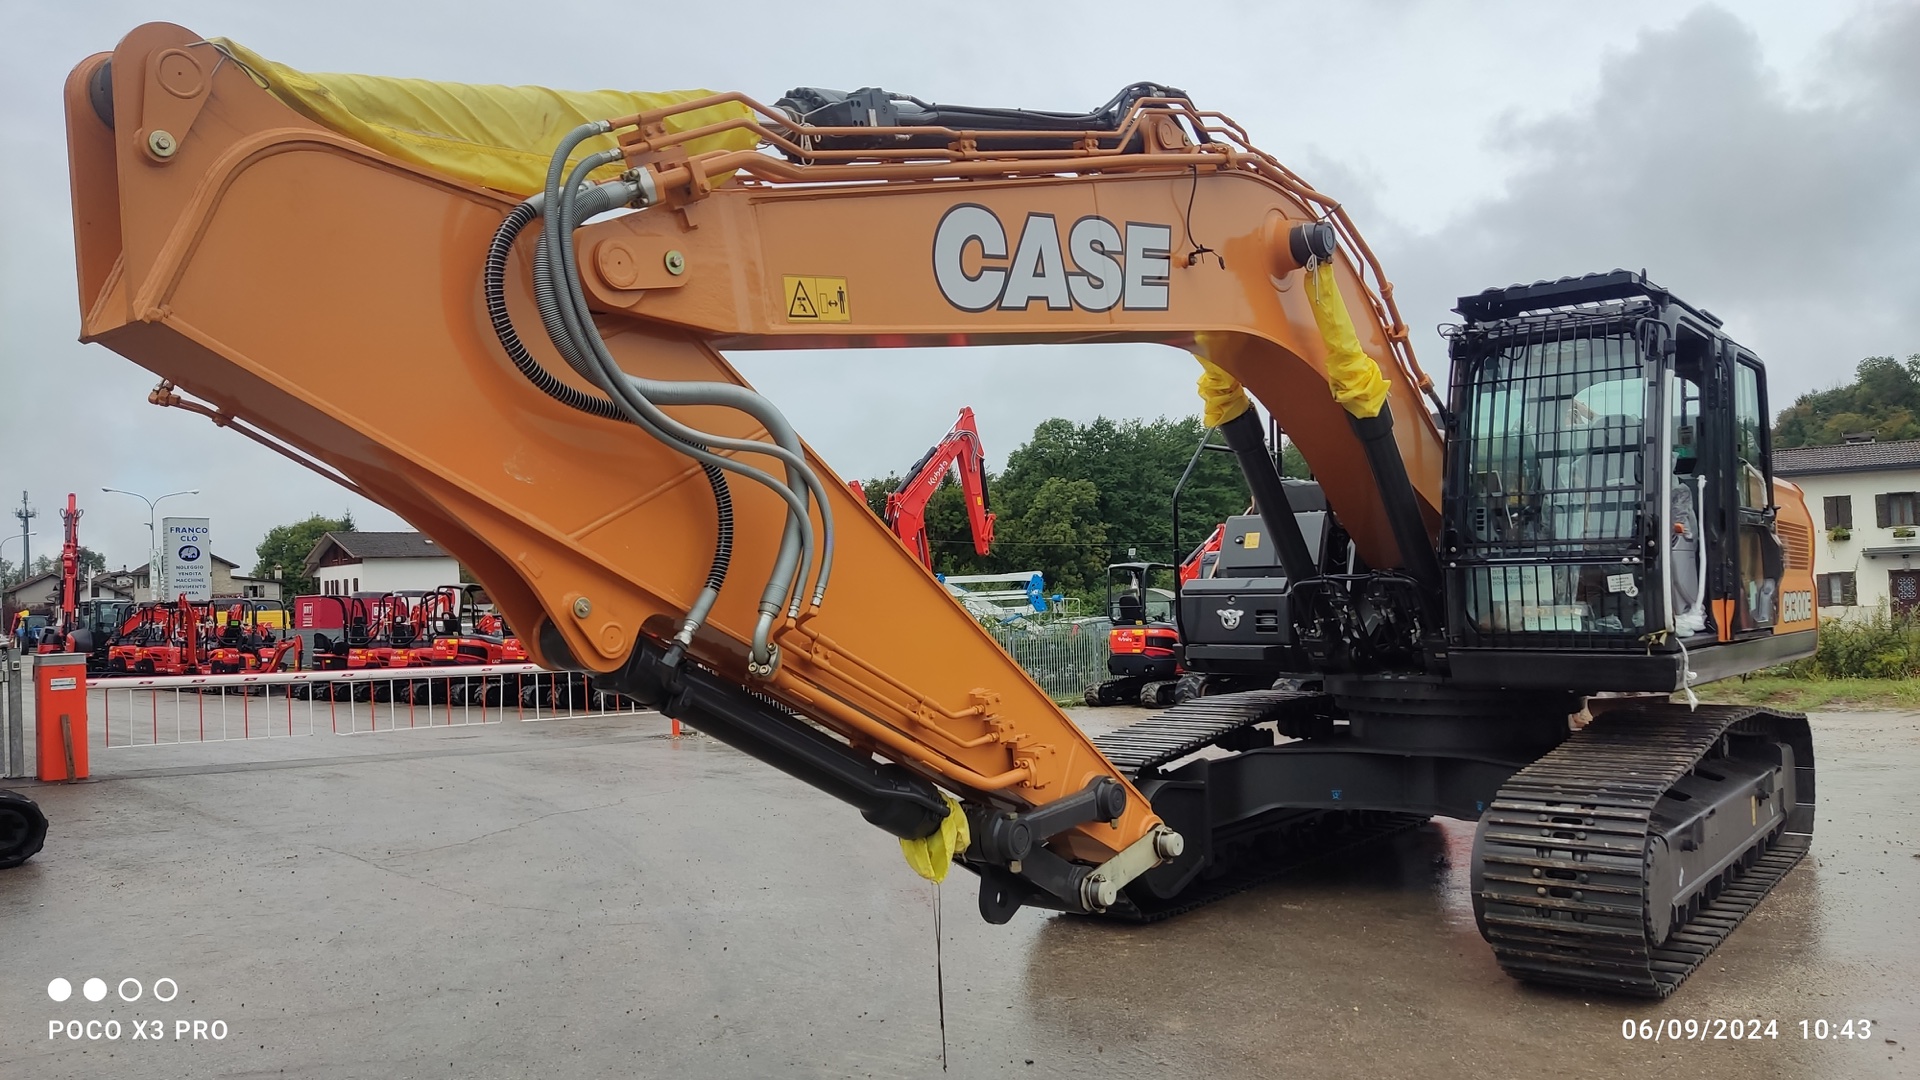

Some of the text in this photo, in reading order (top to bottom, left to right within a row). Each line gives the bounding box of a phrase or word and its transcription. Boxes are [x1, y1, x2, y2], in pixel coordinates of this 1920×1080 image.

[932, 202, 1172, 313] CASE
[1533, 342, 1586, 357] CASE
[928, 460, 948, 486] Kubota
